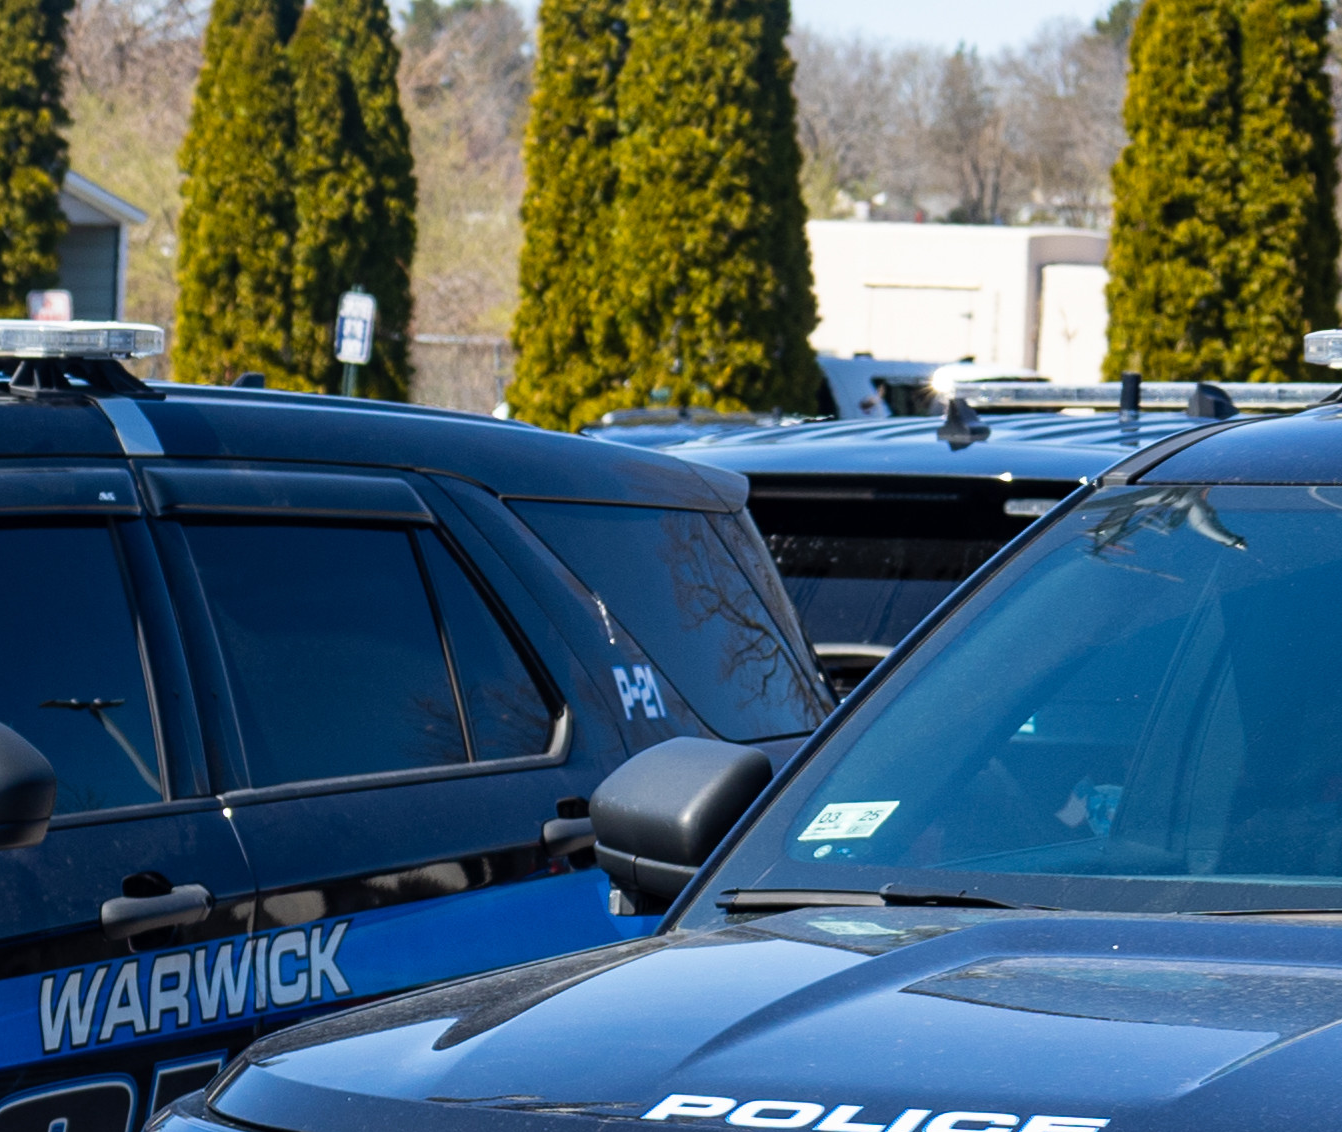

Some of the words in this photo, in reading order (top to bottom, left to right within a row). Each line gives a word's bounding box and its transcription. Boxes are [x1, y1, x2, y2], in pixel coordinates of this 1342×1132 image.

[611, 664, 667, 720] P-21
[819, 812, 842, 823] 03
[858, 810, 884, 821] 25
[39, 919, 352, 1053] WARWICK
